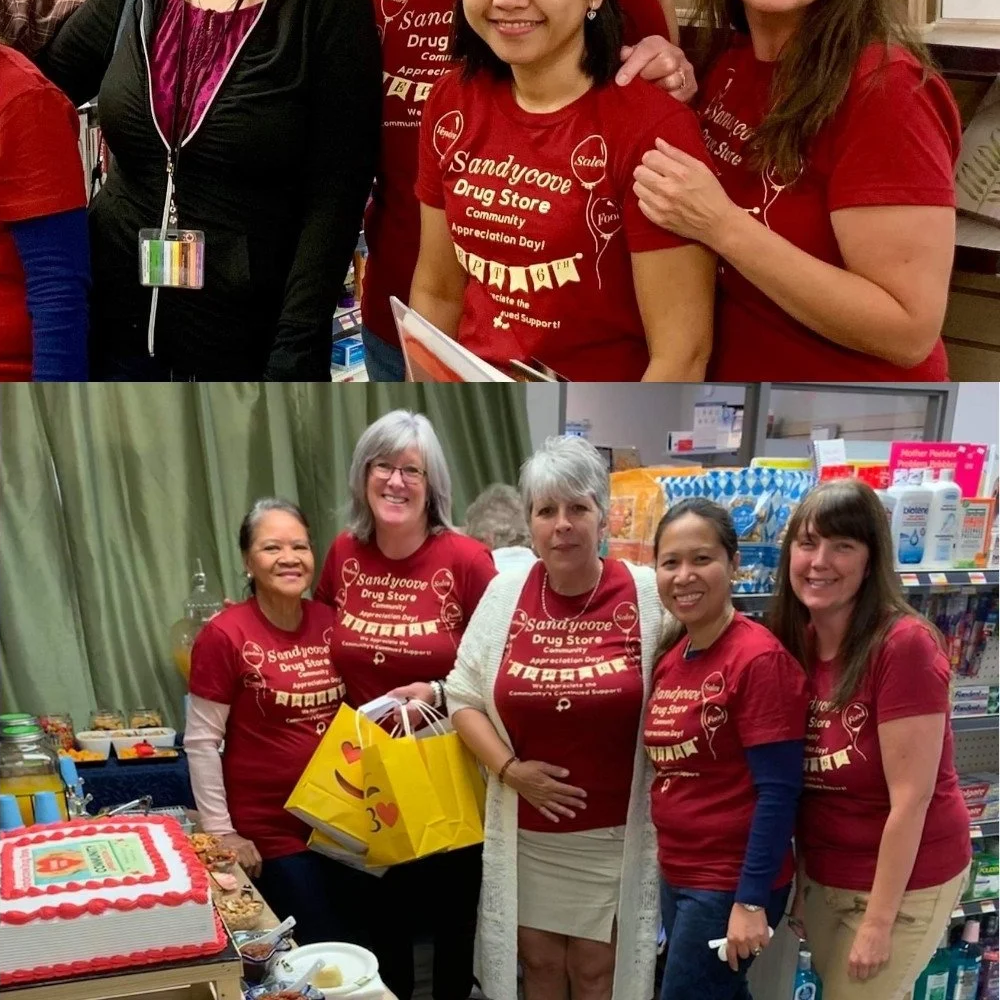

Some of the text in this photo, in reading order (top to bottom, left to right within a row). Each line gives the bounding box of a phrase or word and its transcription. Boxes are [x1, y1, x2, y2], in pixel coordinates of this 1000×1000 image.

[407, 34, 449, 51] Drug
[408, 108, 421, 116] We
[574, 155, 606, 168] Sales
[448, 151, 572, 195] Sandycove
[453, 179, 551, 214] Drug Store
[466, 207, 526, 229] Community
[451, 222, 545, 252] Appreciation Day!
[516, 299, 530, 309] the
[520, 314, 561, 329] Support!
[356, 573, 428, 591] Sandycove
[361, 589, 417, 602] Drug Store
[371, 602, 407, 611] Community
[525, 617, 612, 633] Sandycove
[532, 634, 602, 647] Drug Store
[543, 646, 588, 654] Community
[279, 662, 305, 672] Drug
